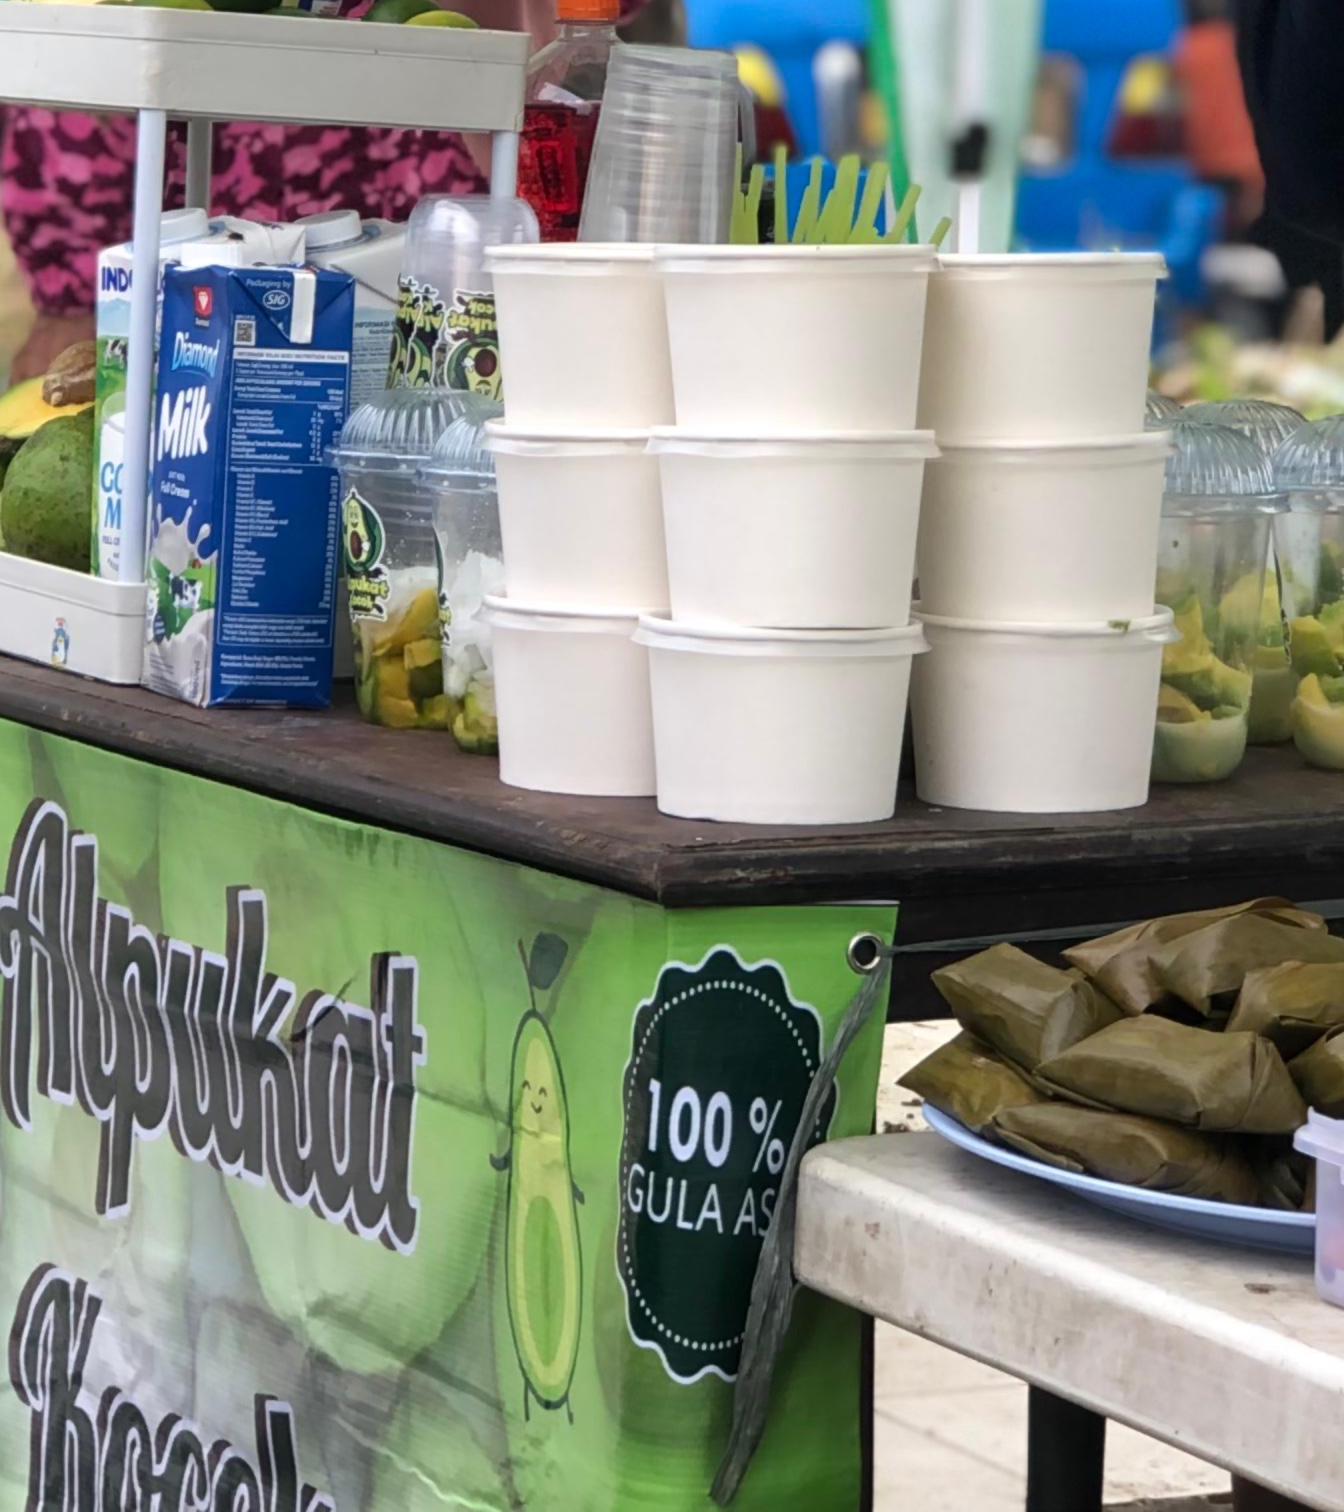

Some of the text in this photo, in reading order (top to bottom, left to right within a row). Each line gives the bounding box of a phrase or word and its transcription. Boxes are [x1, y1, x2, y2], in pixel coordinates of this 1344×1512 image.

[266, 294, 286, 305] SIG
[171, 331, 221, 378] Diamond
[157, 385, 212, 462] Milk
[648, 1077, 733, 1168] 100
[627, 1163, 776, 1237] GULA AS
